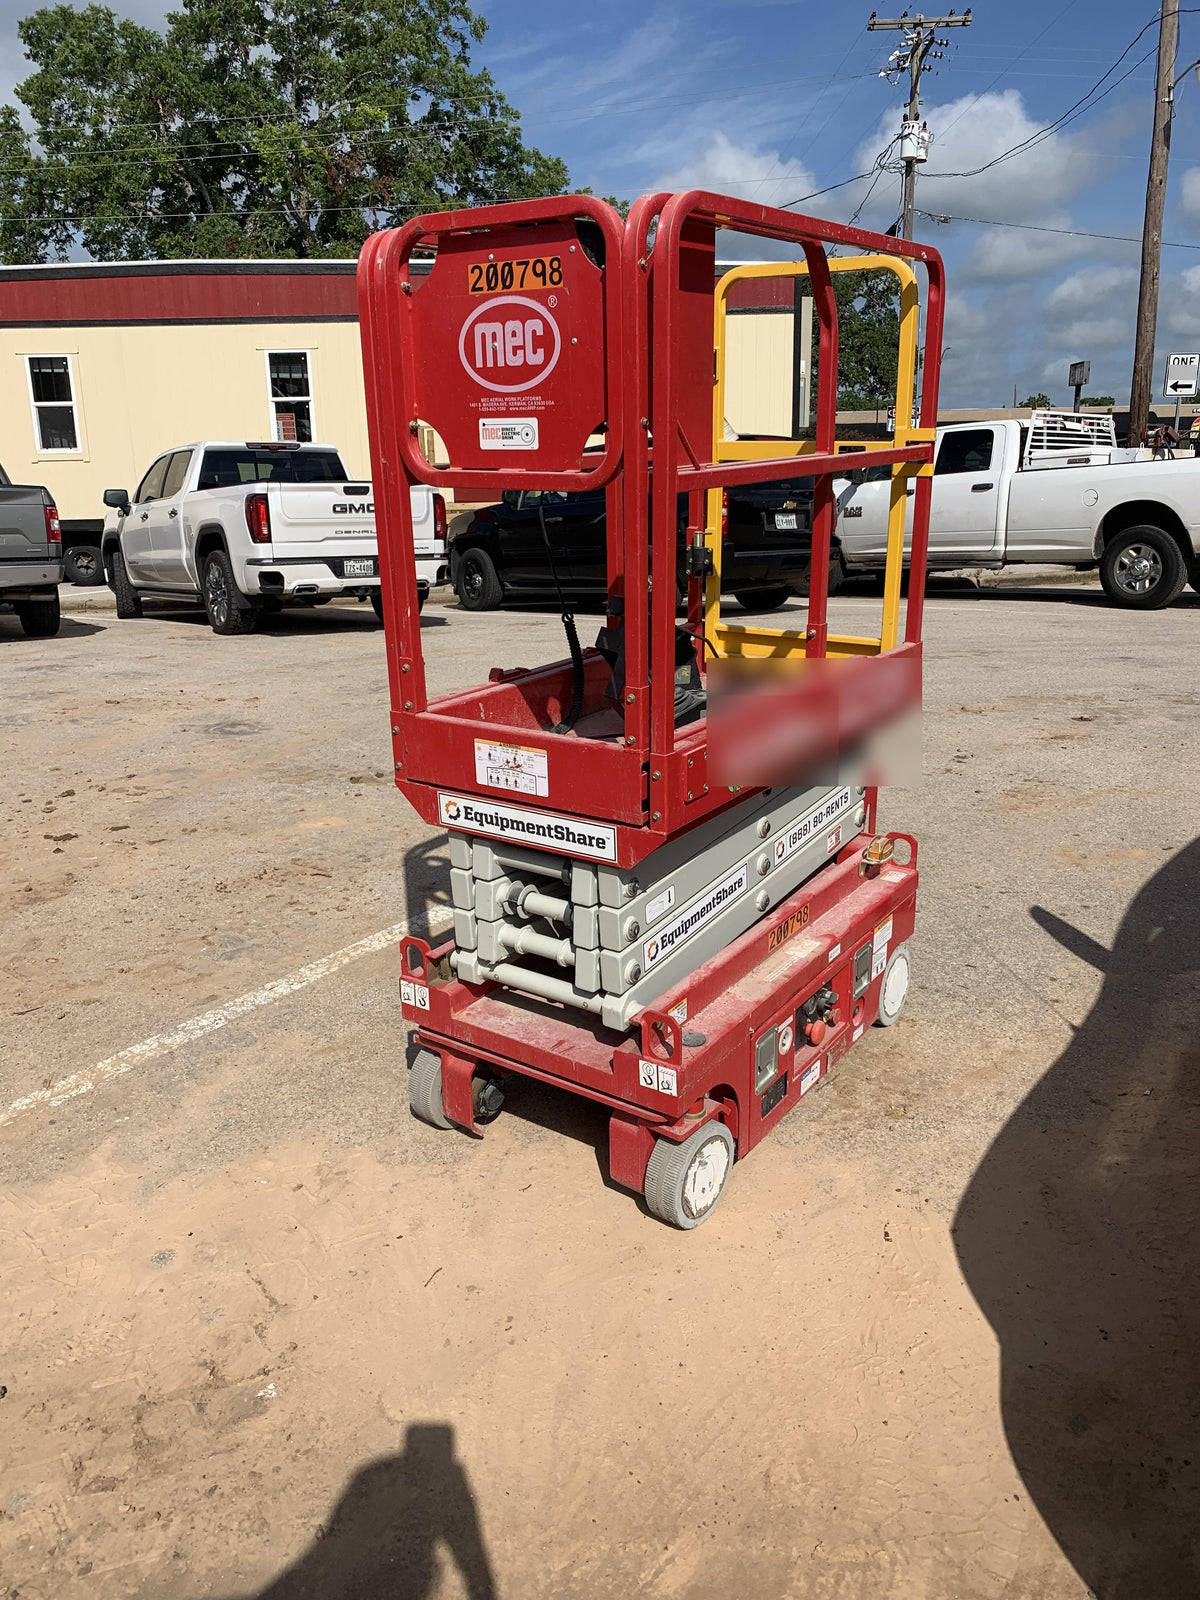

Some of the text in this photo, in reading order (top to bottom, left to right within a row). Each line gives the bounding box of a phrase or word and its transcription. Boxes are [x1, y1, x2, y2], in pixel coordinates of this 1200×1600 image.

[470, 256, 563, 292] 200798
[463, 805, 607, 850] EquipmentShare
[789, 821, 811, 849] (888)
[660, 876, 744, 951] EquipmentShare
[769, 905, 809, 949] 200798
